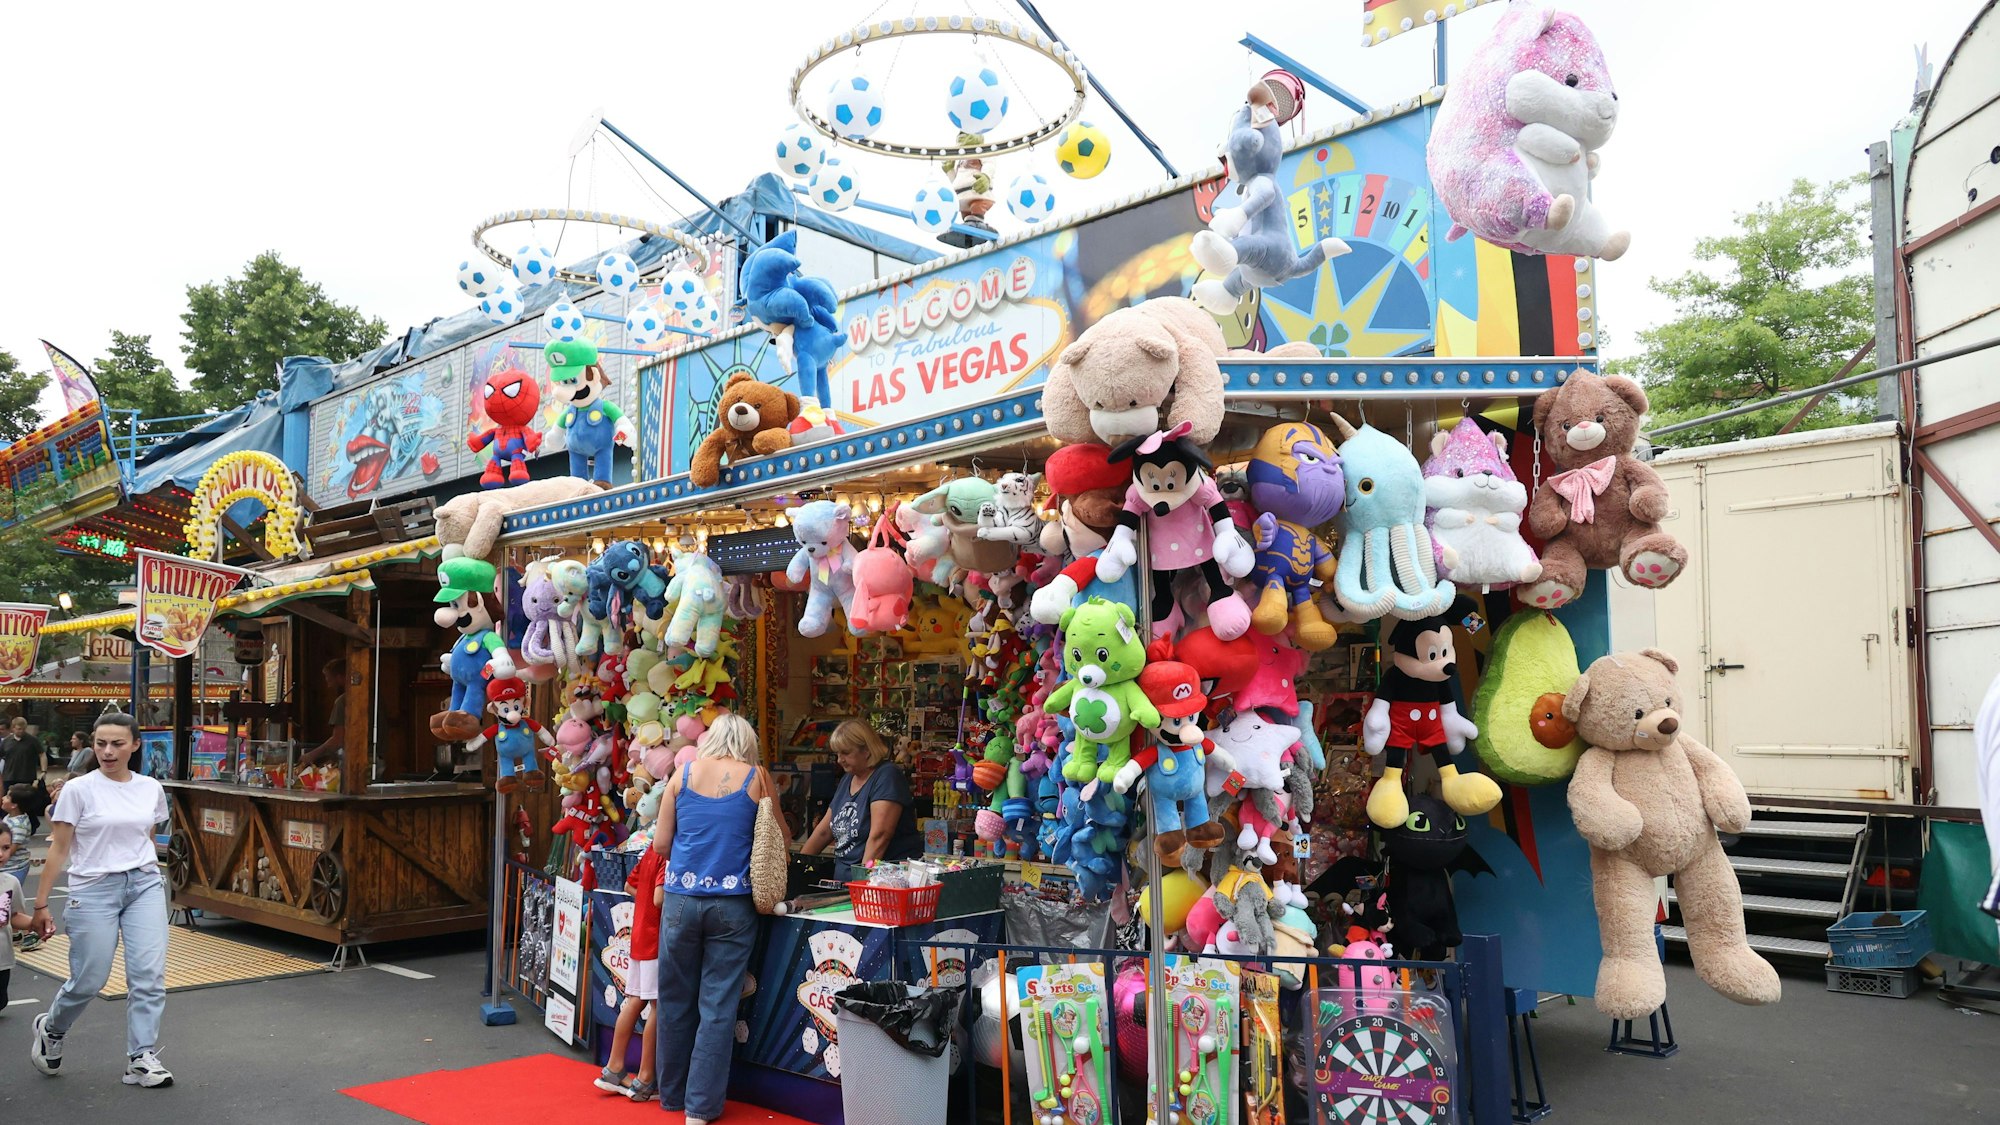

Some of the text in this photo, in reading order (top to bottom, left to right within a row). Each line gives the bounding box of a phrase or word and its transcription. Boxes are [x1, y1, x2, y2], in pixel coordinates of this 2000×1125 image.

[1341, 195, 1352, 214] 1
[1361, 194, 1375, 214] 2
[1381, 201, 1400, 220] 10
[1298, 208, 1308, 228] 5
[1402, 209, 1418, 229] 1
[850, 266, 1027, 346] WELCOME
[868, 323, 1003, 368] TO Fabulous
[852, 333, 1029, 413] LAS VEGAS
[0, 613, 41, 638] rros
[90, 686, 126, 695] Steaks
[851, 829, 859, 838] 83
[610, 955, 630, 970] CAS
[1077, 984, 1097, 992] Set
[1211, 979, 1230, 990] Set
[809, 993, 835, 1010] CAS
[1355, 1020, 1361, 1028] 5
[1372, 1018, 1383, 1027] 20
[1337, 1027, 1345, 1036] 12
[1410, 1032, 1419, 1041] 18
[1426, 1048, 1433, 1057] 4
[1319, 1055, 1326, 1064] 14
[1434, 1067, 1444, 1077] 13
[1359, 1074, 1385, 1082] DART
[1373, 1081, 1401, 1090] GAME
[1321, 1094, 1327, 1102] 8
[1436, 1106, 1446, 1115] 10
[1328, 1111, 1336, 1120] 16
